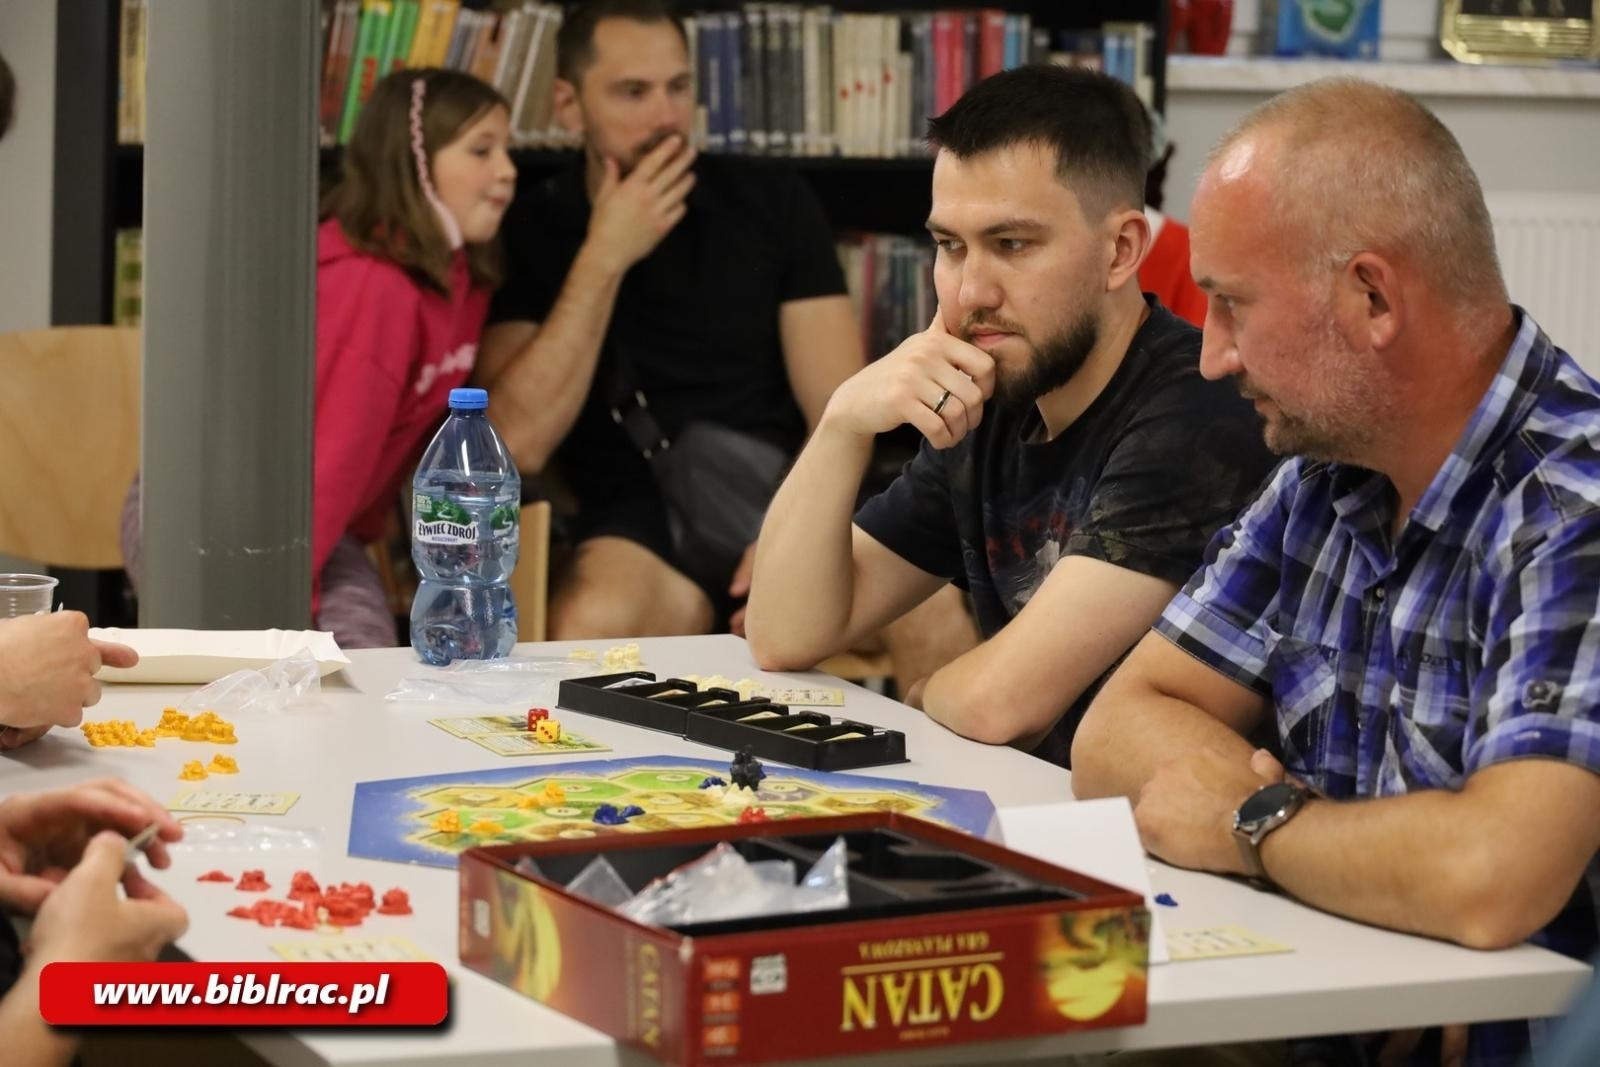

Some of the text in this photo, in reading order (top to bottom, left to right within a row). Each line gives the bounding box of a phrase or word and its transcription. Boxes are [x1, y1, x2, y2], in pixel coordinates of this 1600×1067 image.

[418, 521, 445, 536] ŻYWIEC
[447, 523, 476, 540] ZDRÓJ
[859, 931, 989, 959] GRA PLANSZOWA
[841, 962, 1004, 1032] CATAN
